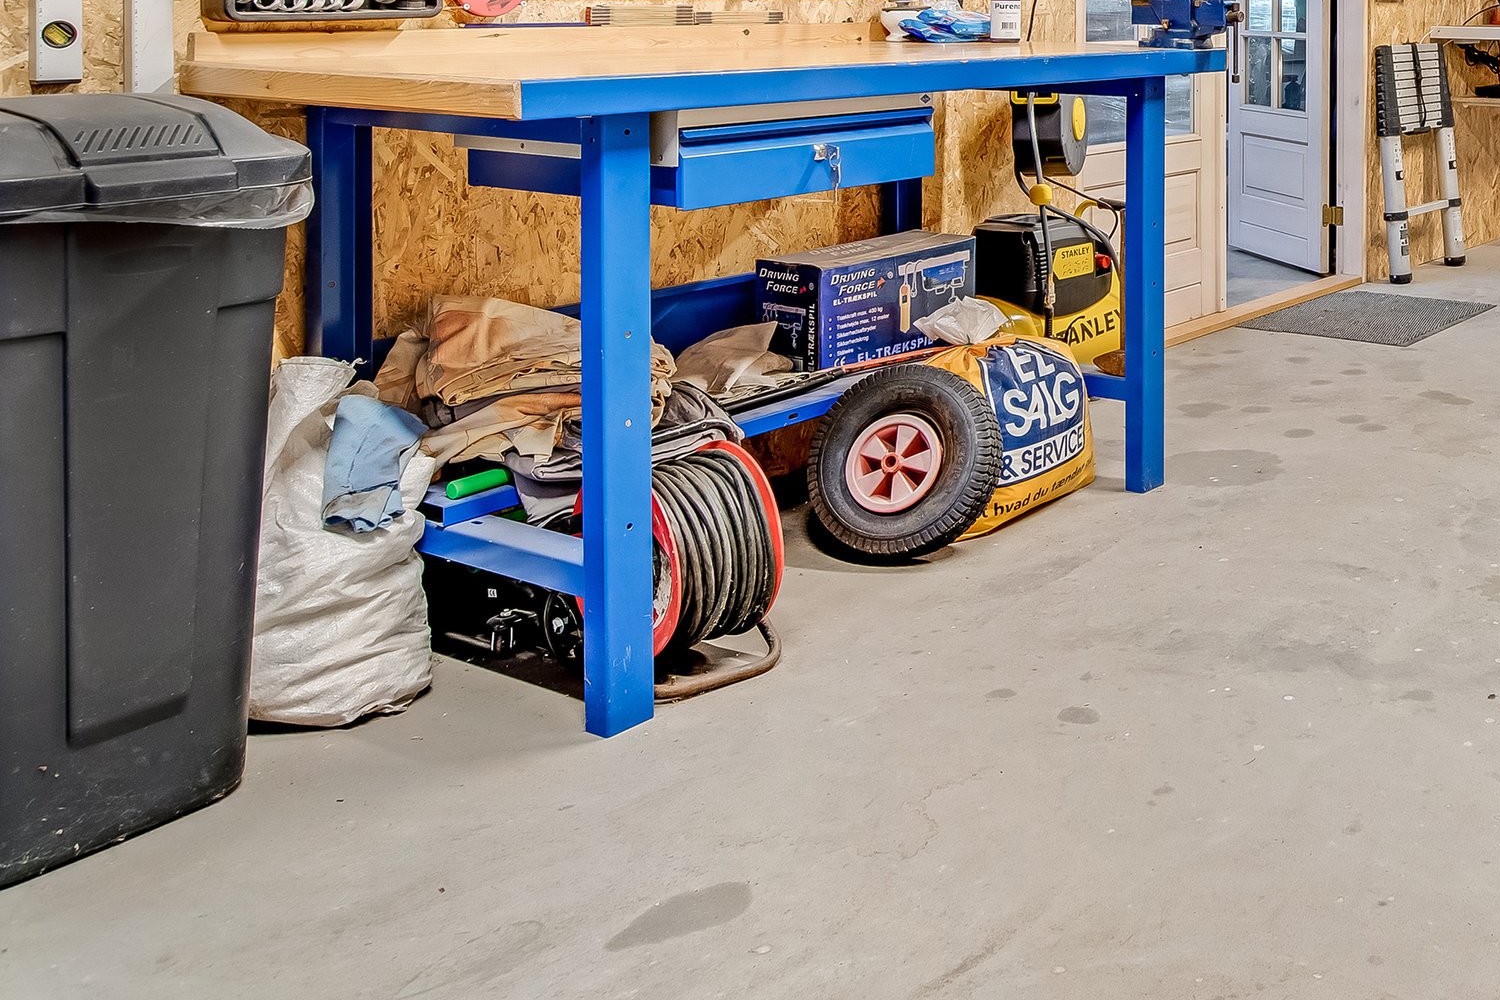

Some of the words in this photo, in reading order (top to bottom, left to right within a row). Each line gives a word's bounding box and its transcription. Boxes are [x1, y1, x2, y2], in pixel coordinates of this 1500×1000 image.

[1061, 246, 1090, 259] STANLEY
[759, 268, 800, 282] DRIVING
[830, 268, 876, 286] DRIVING
[766, 281, 799, 295] FORCE
[833, 291, 878, 306] EL-TRÆKSPIL
[838, 280, 876, 296] FORCE
[807, 303, 815, 372] EL-TRÆKSPIL
[857, 336, 934, 363] EL-TRÆKSPIL
[1003, 346, 1055, 383] EL
[1003, 371, 1080, 438] SALG
[1000, 454, 1019, 480] &
[1021, 425, 1084, 475] SERVICE
[994, 493, 1031, 517] hvad
[1033, 487, 1049, 502] du
